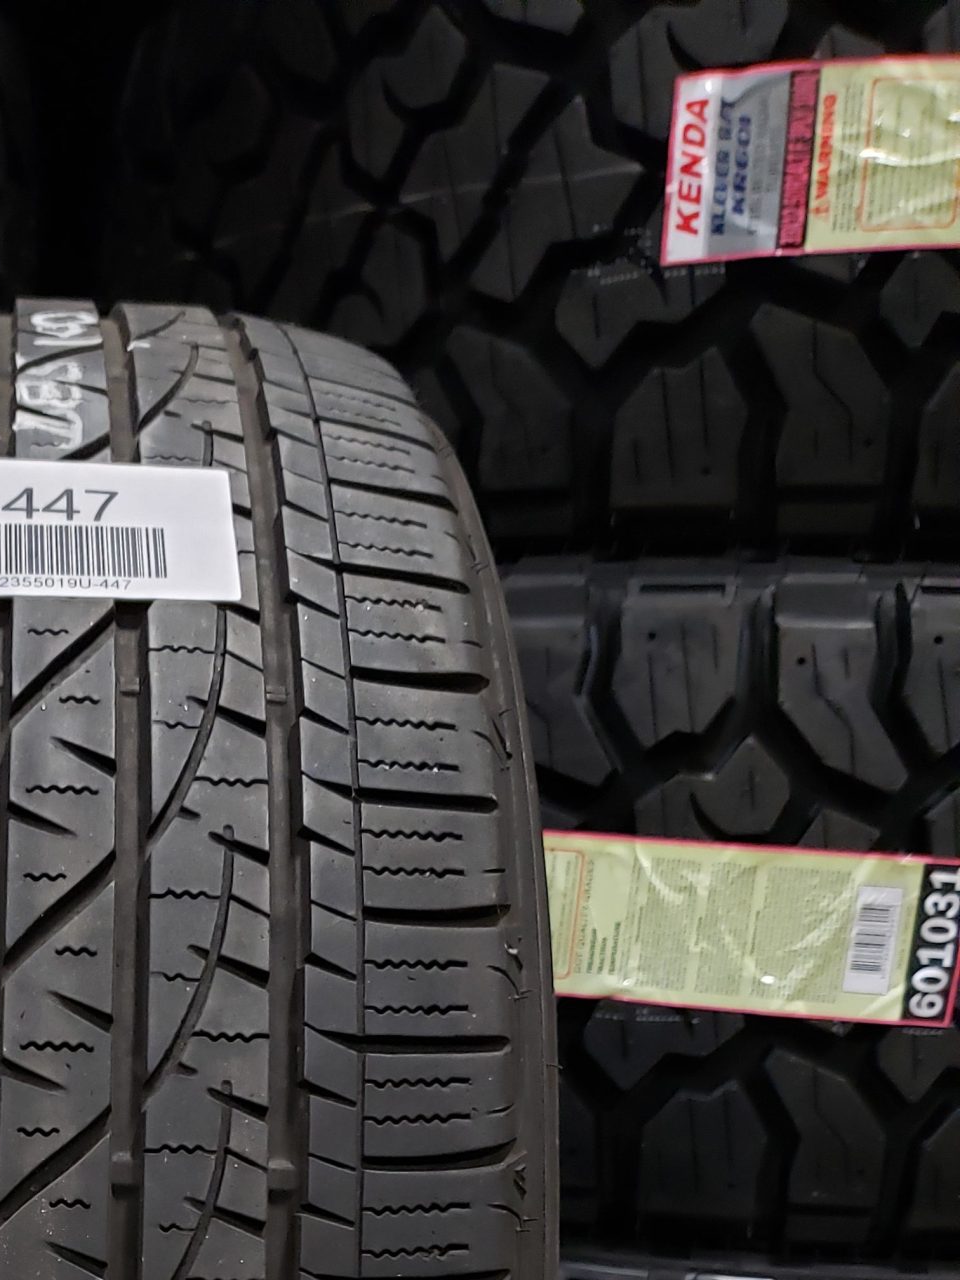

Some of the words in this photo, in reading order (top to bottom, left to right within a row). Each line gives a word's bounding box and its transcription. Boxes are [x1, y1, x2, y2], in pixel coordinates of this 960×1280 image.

[676, 98, 710, 235] KENDA
[1, 487, 119, 522] 447
[0, 576, 132, 590] 2355019U-447
[908, 867, 960, 1018] 601031
